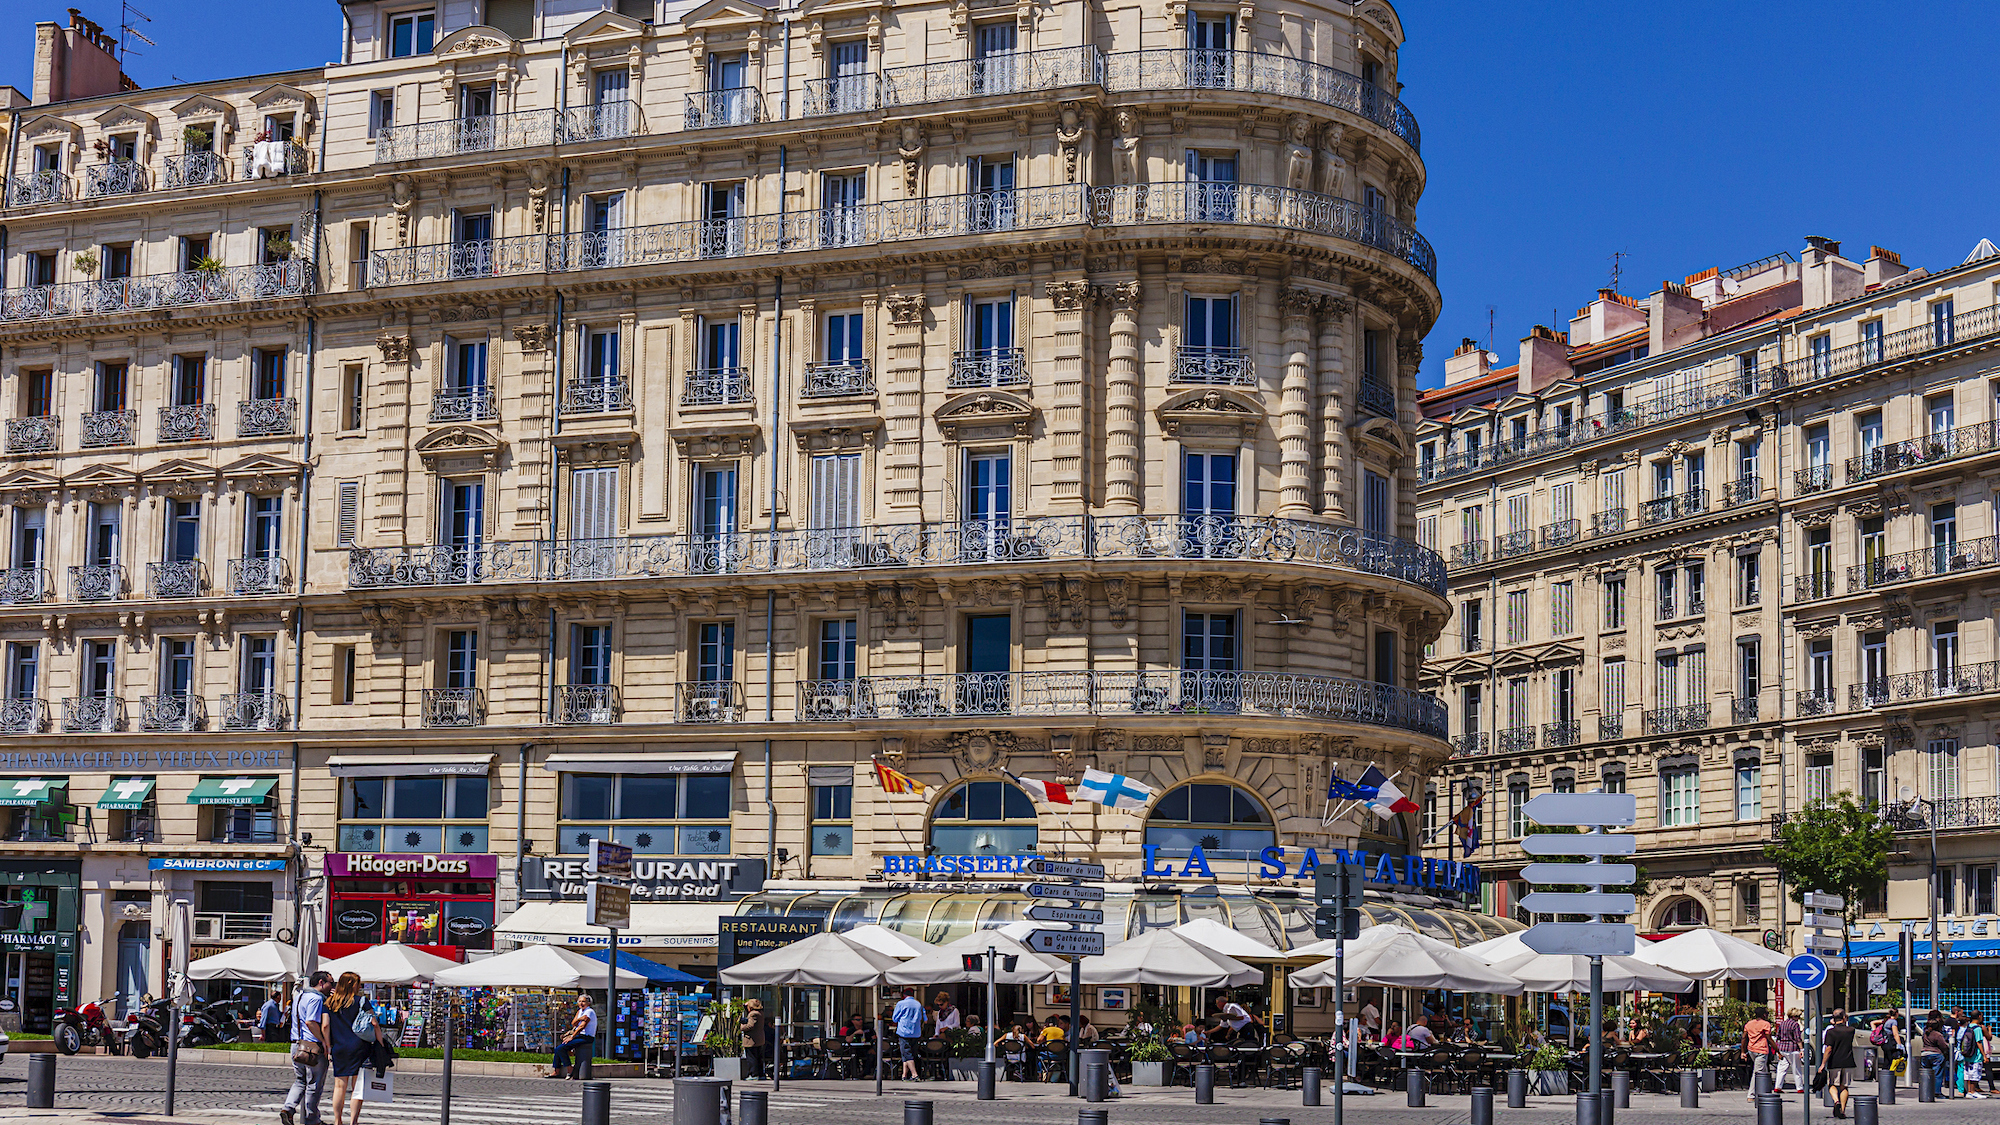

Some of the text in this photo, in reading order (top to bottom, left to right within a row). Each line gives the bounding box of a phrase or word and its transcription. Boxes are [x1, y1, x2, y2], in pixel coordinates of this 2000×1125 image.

[0, 749, 284, 768] PHARMACIE DU VIEUX PORT
[163, 859, 240, 869] SAMBRONI
[347, 854, 468, 877] Häagen-Dazs
[1141, 843, 1216, 878] LA
[1054, 865, 1073, 874] Hôtel
[1075, 866, 1084, 874] de
[1087, 867, 1102, 876] Ville
[655, 885, 680, 896] au
[681, 883, 721, 897] Sud
[1044, 887, 1059, 896] Cars
[1062, 888, 1071, 896] de
[1074, 889, 1102, 898] Tourisme
[1051, 910, 1087, 920] Esplanade
[451, 920, 482, 928] Häagen-Dazs
[721, 922, 818, 934] RESTAURANT
[504, 933, 547, 943] CARTERIE
[663, 937, 715, 945] SOUVENIRS
[737, 939, 753, 947] Une
[755, 939, 778, 948] Table,
[1056, 934, 1096, 943] Cathédrale
[1081, 945, 1102, 953] Major
